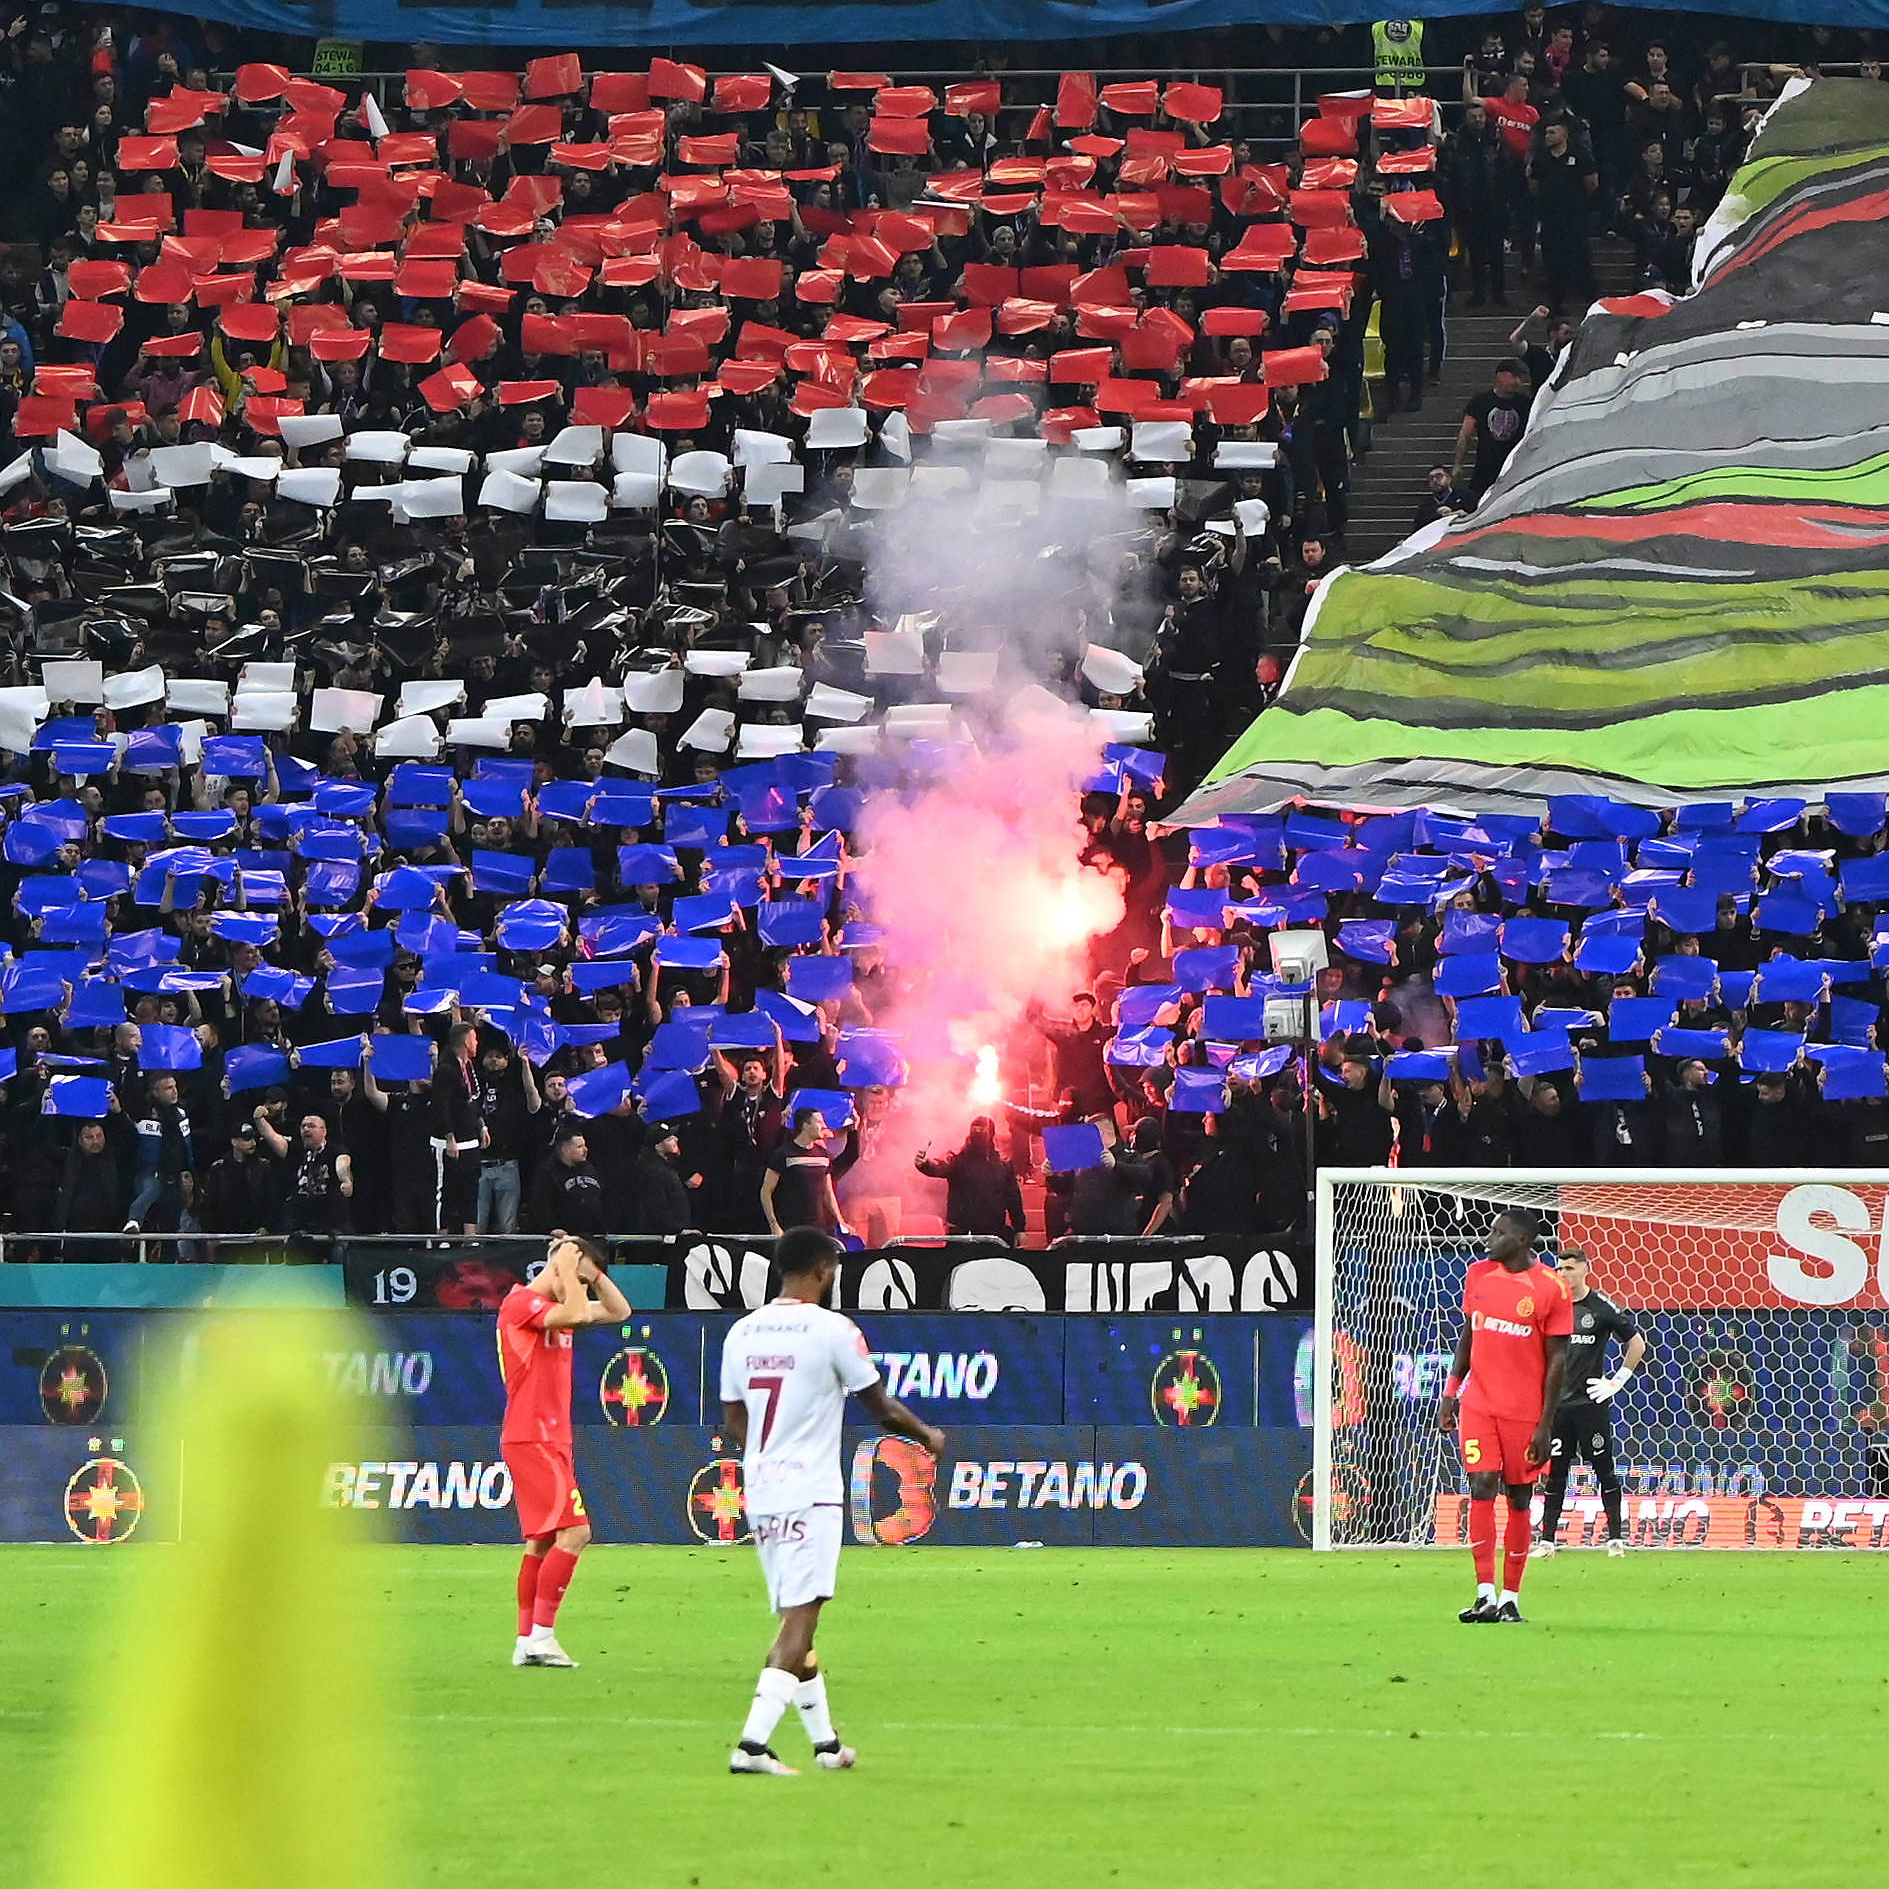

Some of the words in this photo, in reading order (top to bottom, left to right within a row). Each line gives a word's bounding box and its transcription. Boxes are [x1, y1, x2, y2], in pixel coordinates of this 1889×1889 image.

[373, 1267, 417, 1304] 19
[1484, 1317, 1533, 1337] BETANO
[1570, 1335, 1596, 1345] TANO
[868, 1352, 998, 1398] TANO
[748, 1377, 784, 1453] 7
[1465, 1439, 1482, 1464] 5
[948, 1461, 1148, 1510] BETANO
